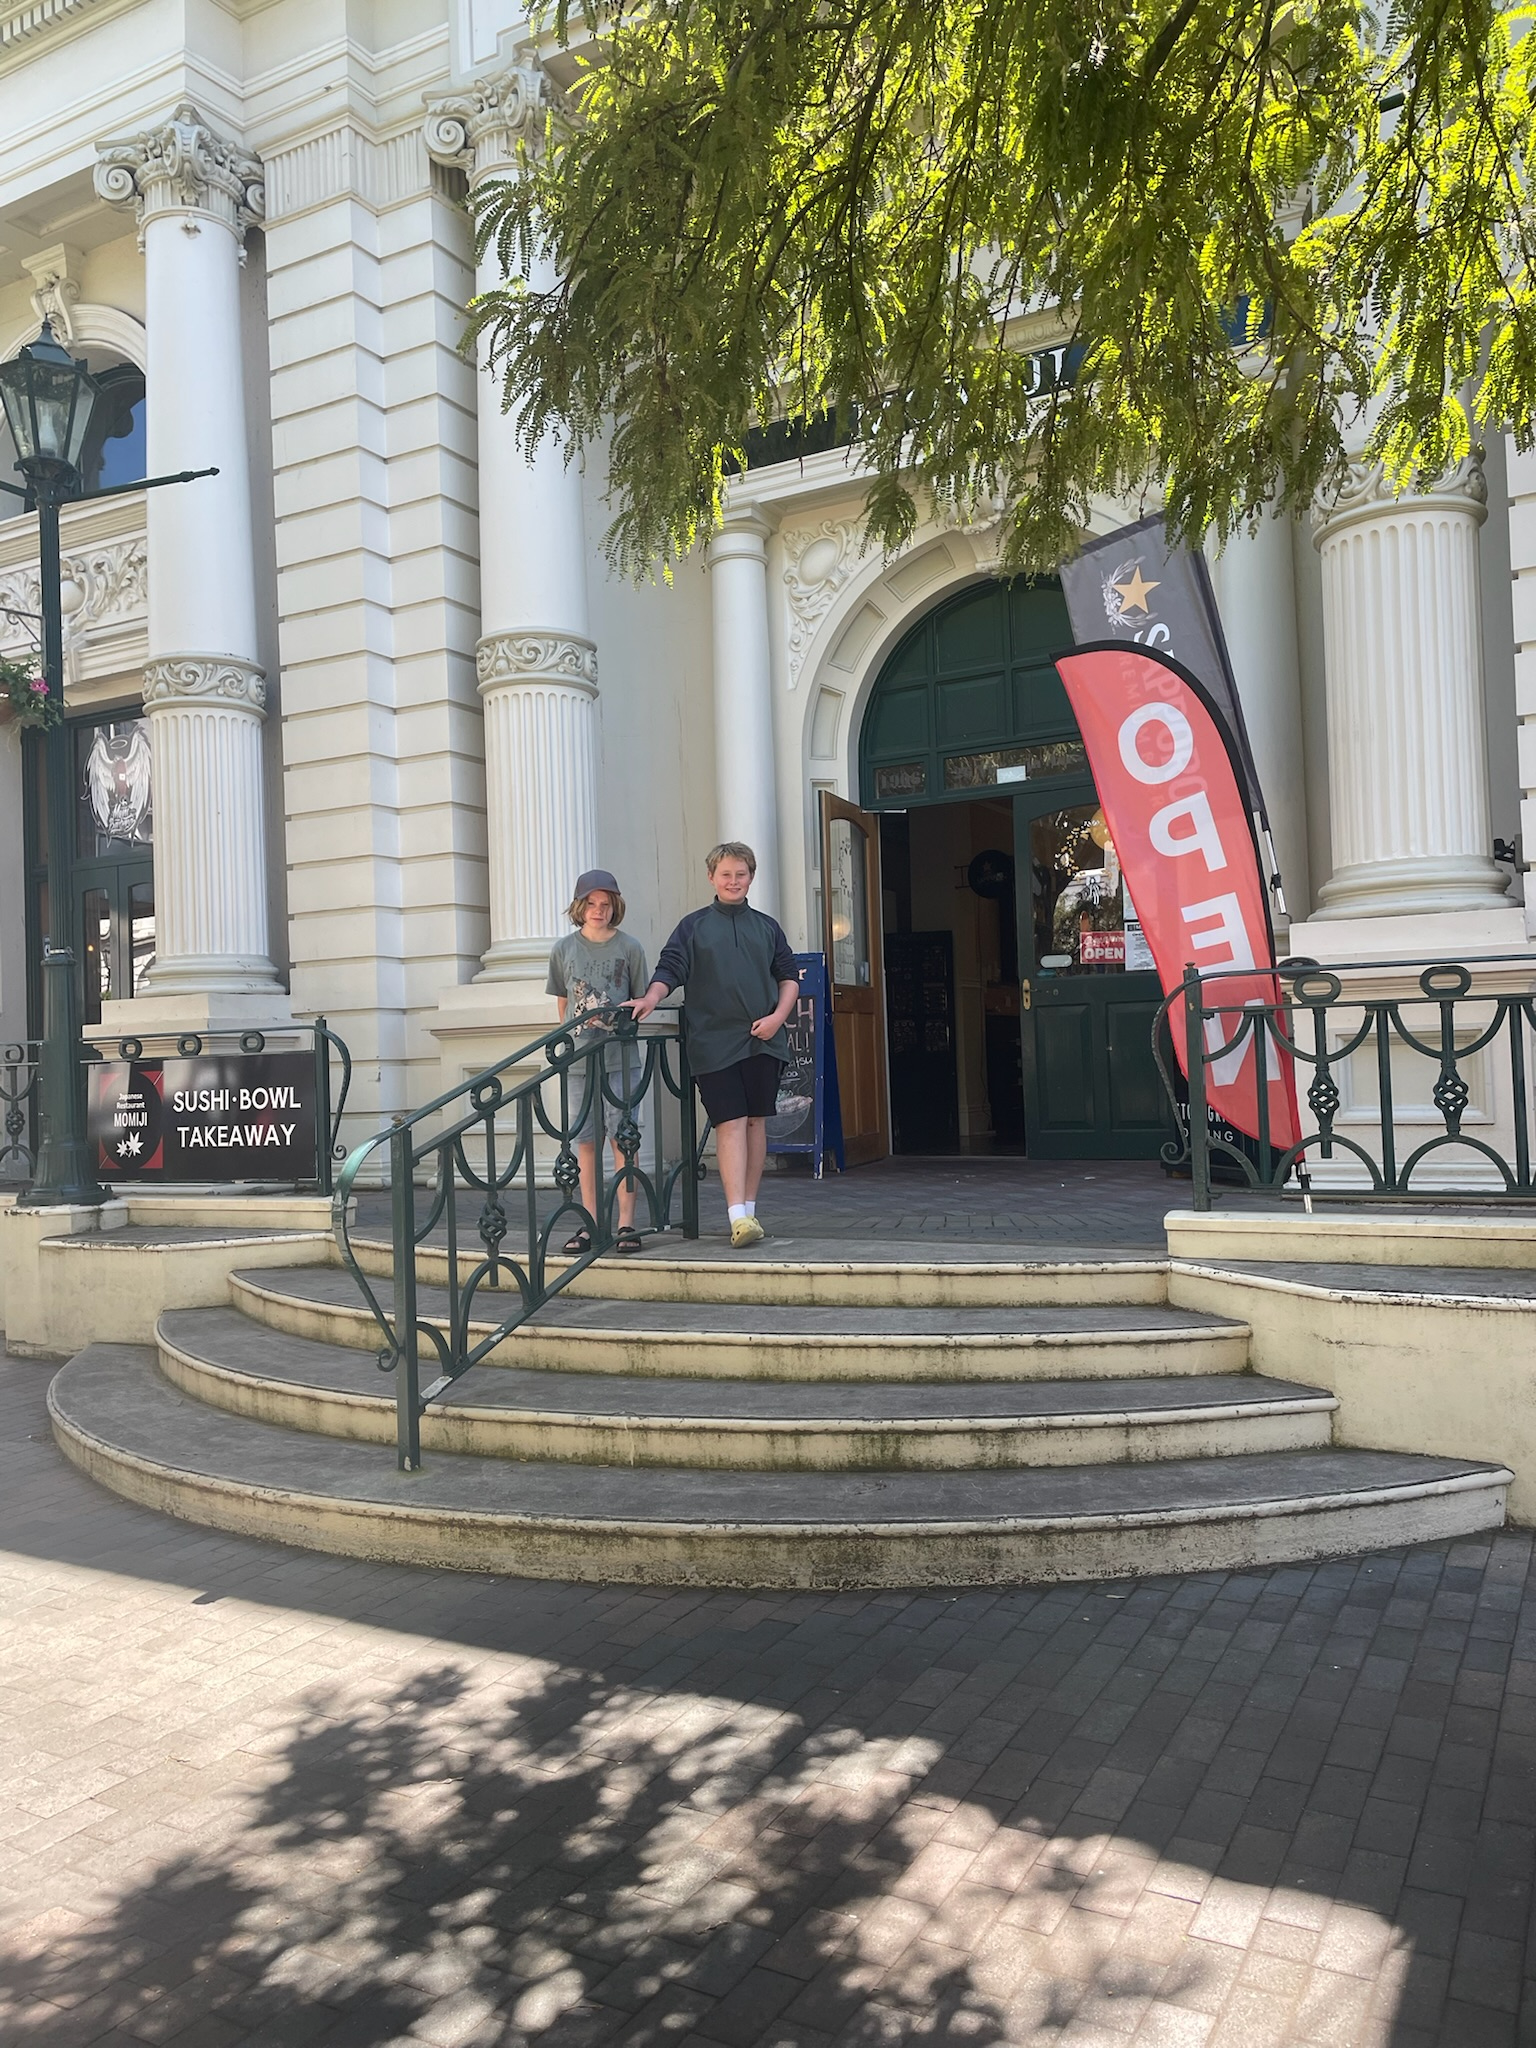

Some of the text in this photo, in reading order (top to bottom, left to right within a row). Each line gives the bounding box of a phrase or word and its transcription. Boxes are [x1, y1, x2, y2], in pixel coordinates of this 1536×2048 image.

[1084, 948, 1124, 960] OPEN
[118, 1092, 143, 1101] Japanese
[116, 1101, 146, 1109] Restaurant
[113, 1111, 148, 1128] MOMIJI
[176, 1123, 297, 1148] TAKEAWAY
